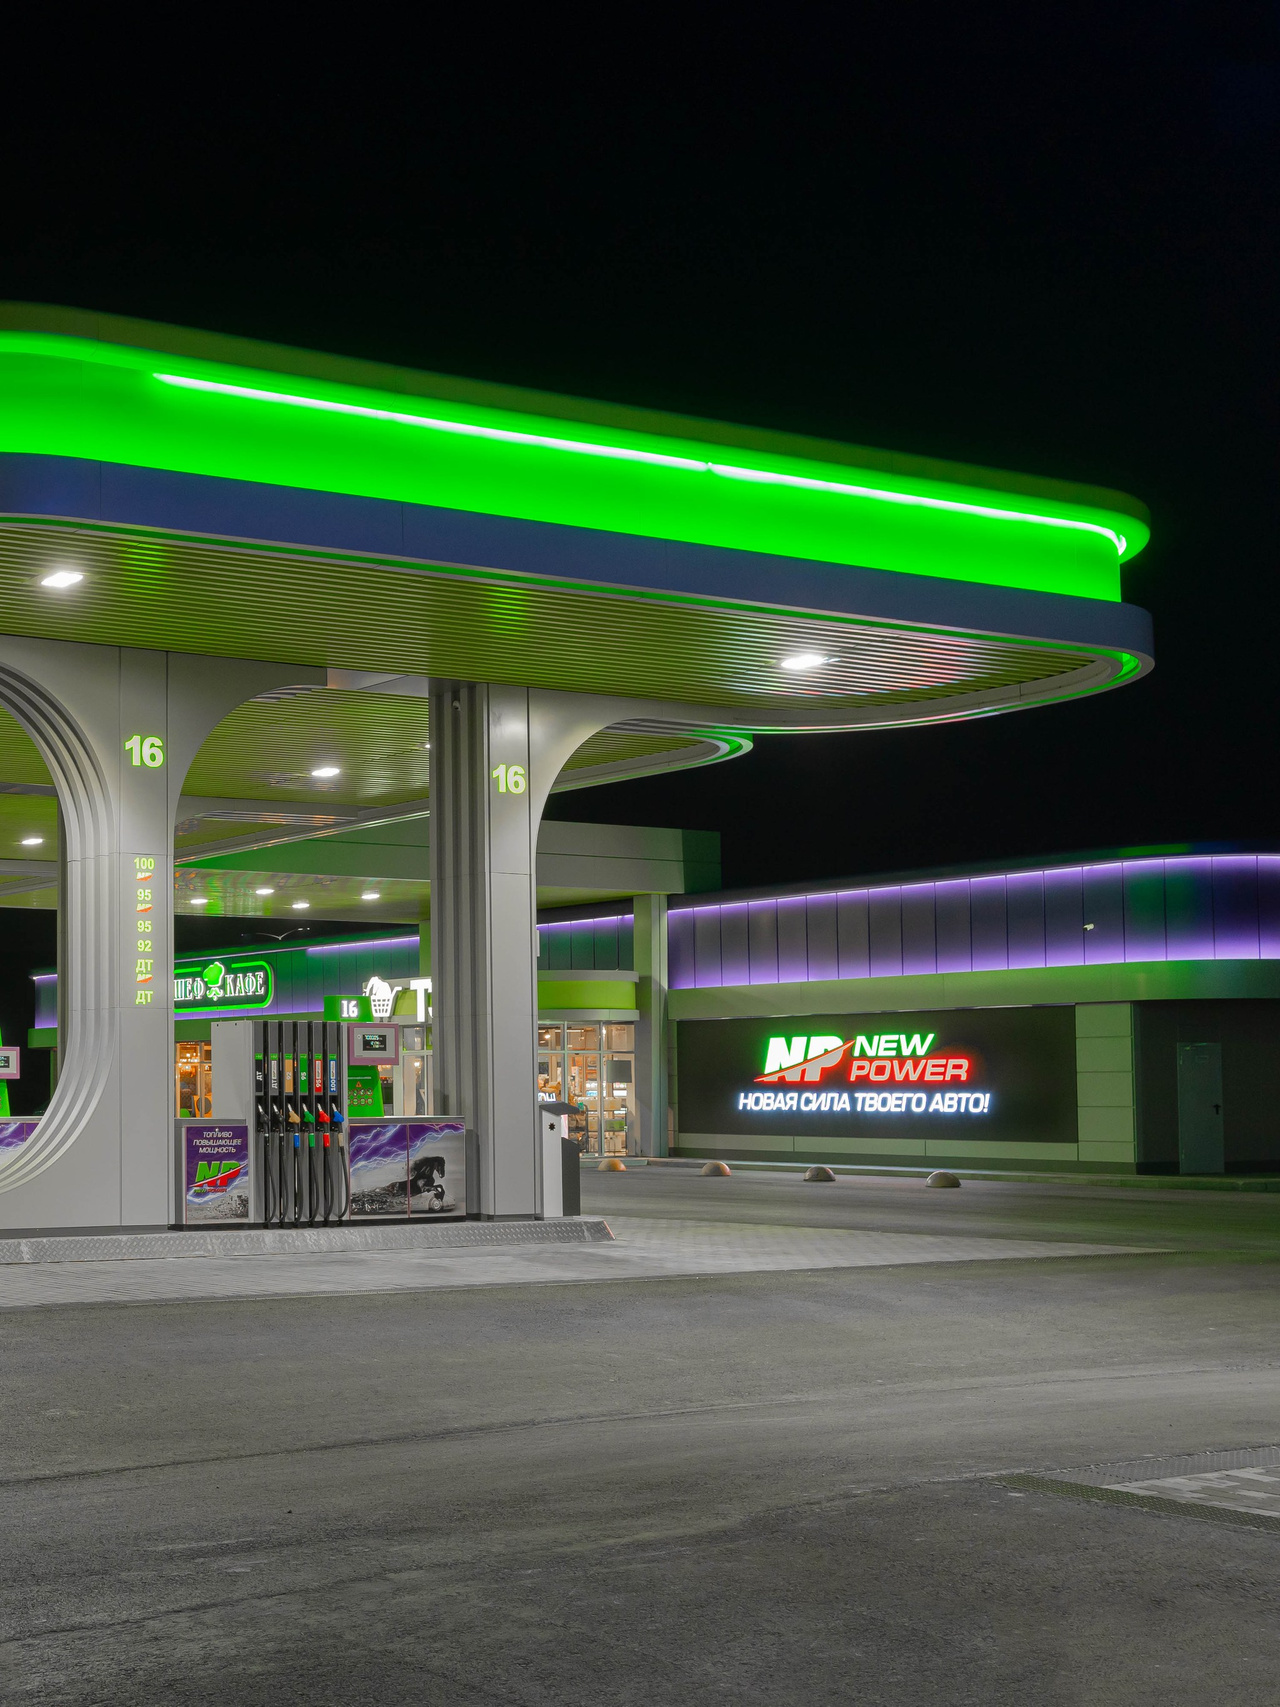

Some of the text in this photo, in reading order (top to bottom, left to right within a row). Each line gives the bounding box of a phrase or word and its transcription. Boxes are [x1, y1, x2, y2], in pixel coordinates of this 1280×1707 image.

[124, 735, 164, 768] 16
[492, 764, 526, 794] 16
[134, 857, 155, 870] 100
[137, 888, 152, 901] 95
[137, 920, 152, 933] 95
[137, 939, 152, 952] 92
[135, 959, 153, 973] ДТ
[224, 971, 265, 997] КАФЕ
[135, 990, 153, 1004] ДТ
[341, 1000, 358, 1018] 16
[853, 1033, 935, 1057] NEW
[759, 1035, 849, 1082] NP
[256, 1071, 263, 1081] ДТ
[301, 1071, 307, 1080] 95
[849, 1058, 969, 1082] POWER
[272, 1080, 278, 1089] ДТ
[316, 1079, 322, 1088] 95
[738, 1092, 990, 1113] НОВАЯ СИЛА ТВОЕГО АВТО!
[193, 1160, 243, 1187] NP
